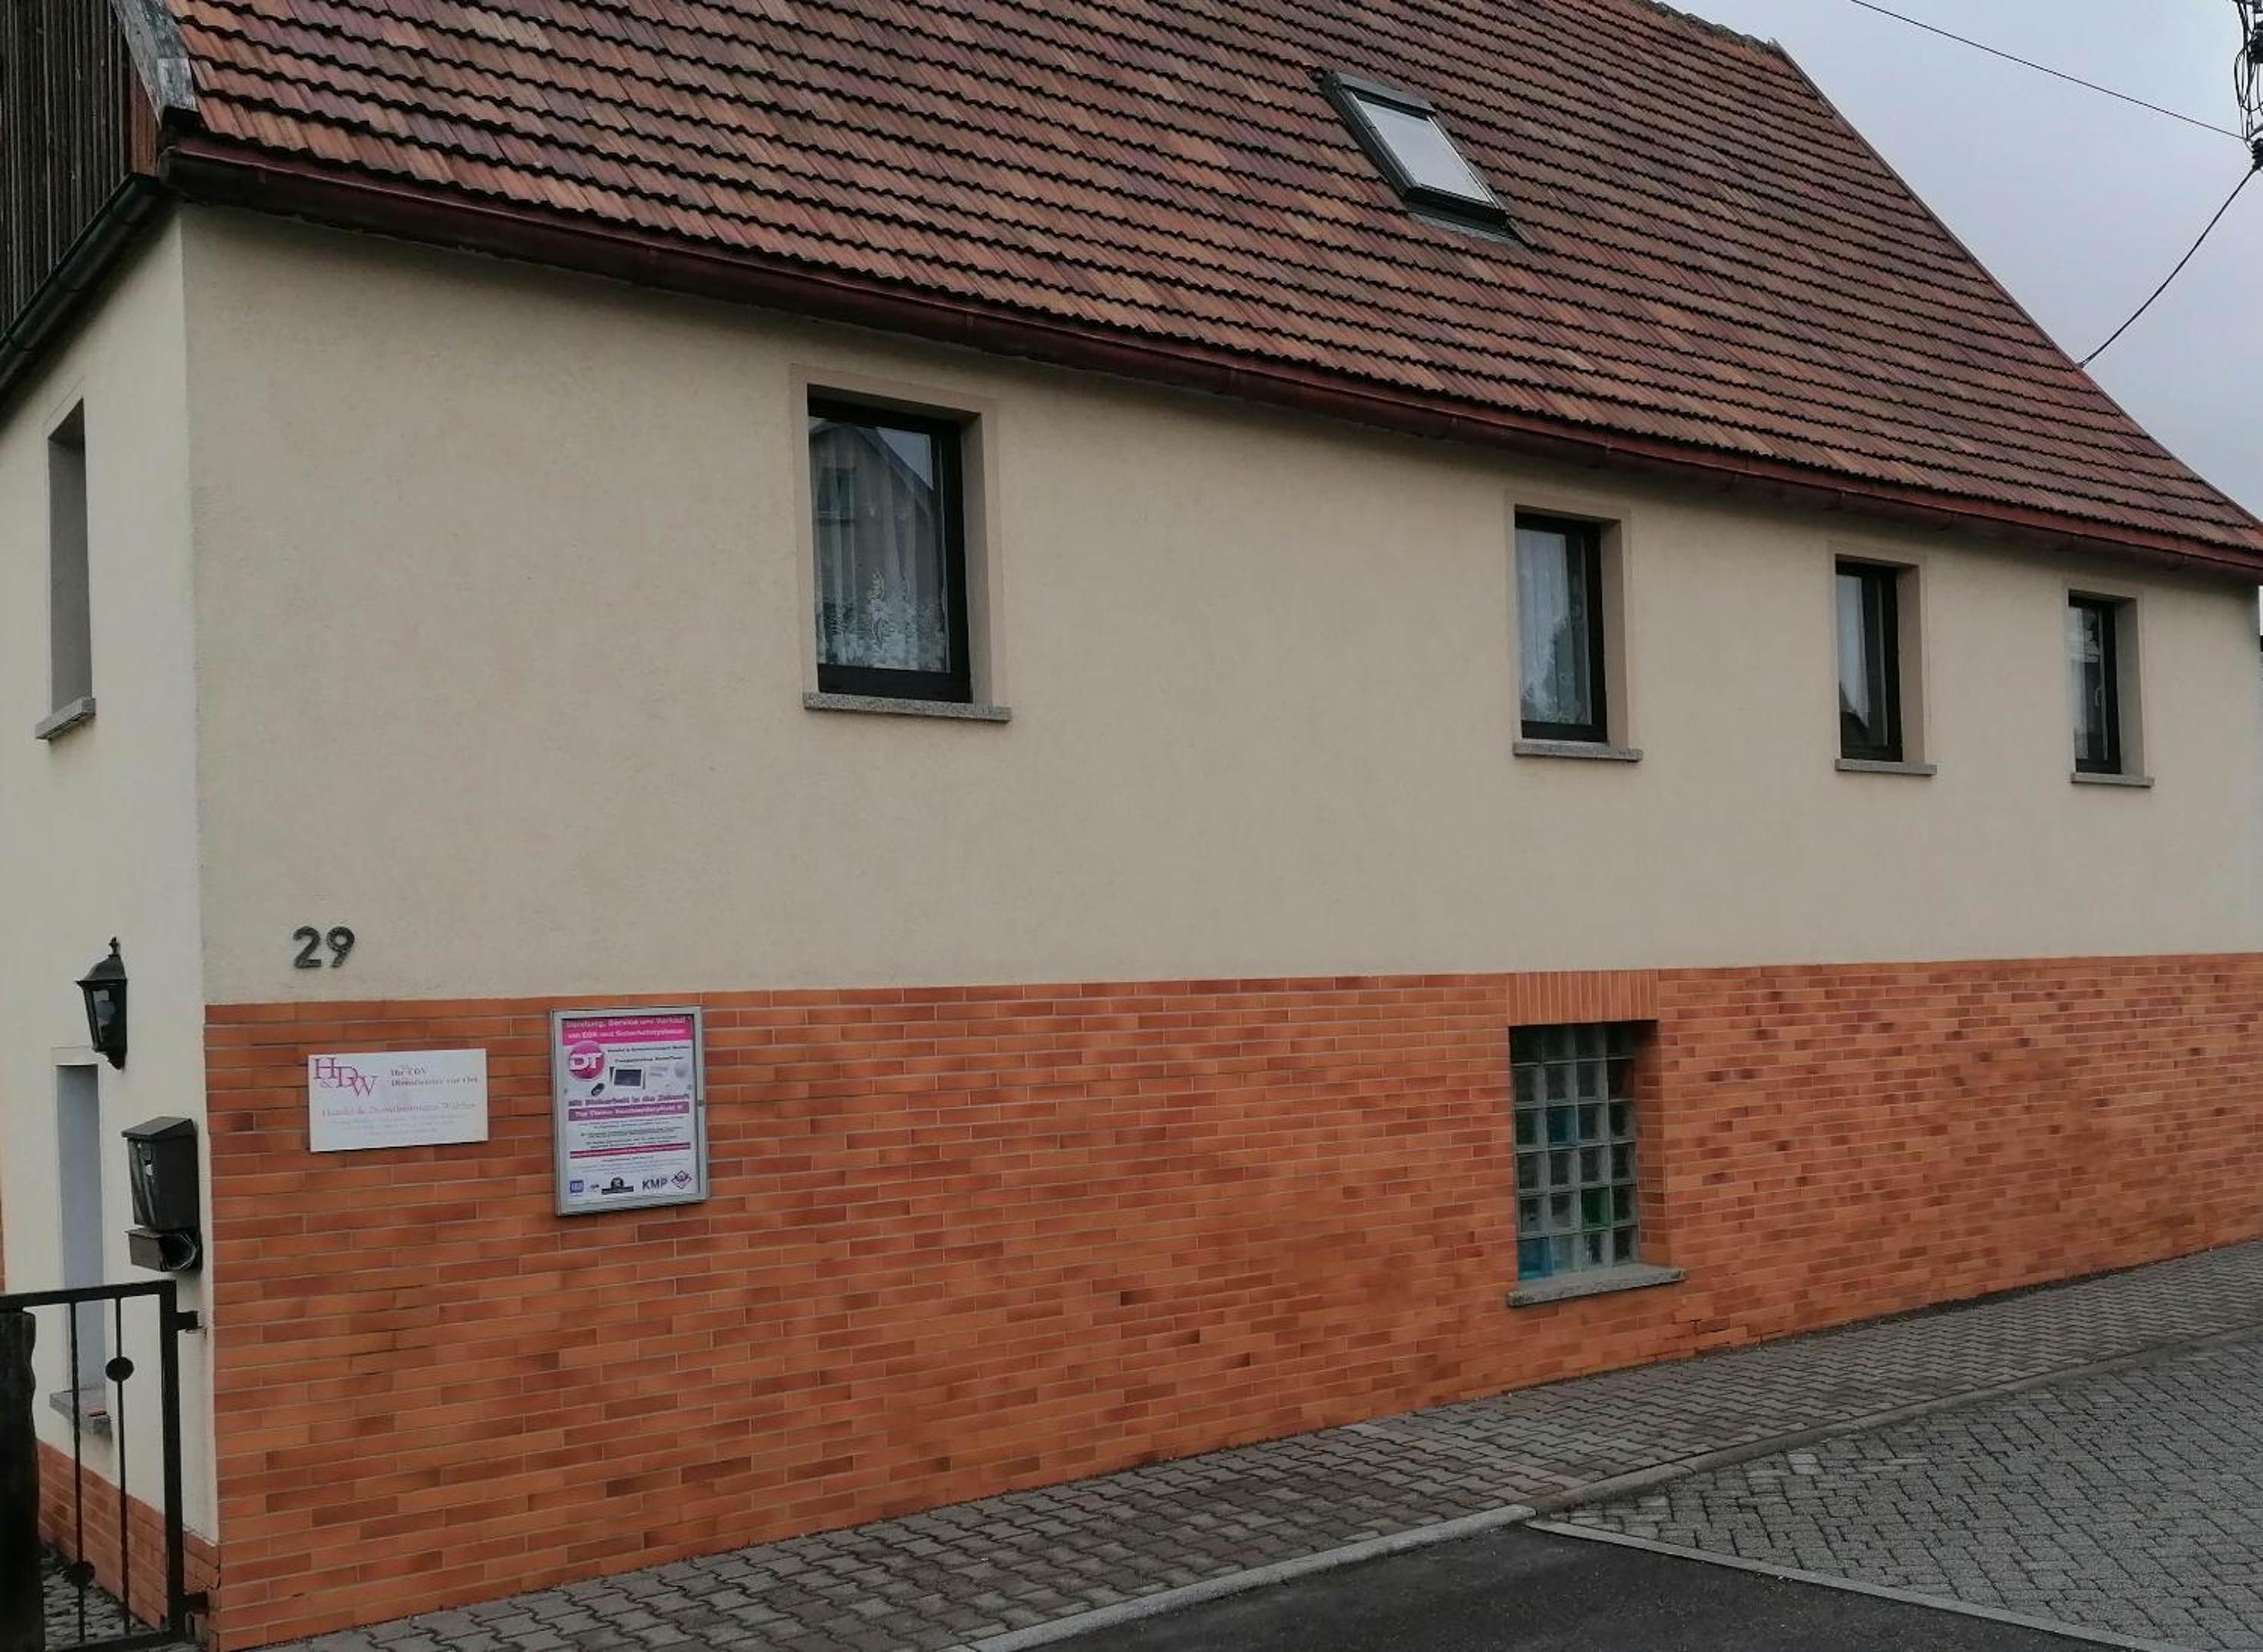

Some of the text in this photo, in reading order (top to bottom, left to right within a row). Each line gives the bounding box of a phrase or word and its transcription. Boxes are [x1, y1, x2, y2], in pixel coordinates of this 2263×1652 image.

[292, 926, 355, 969] 29
[607, 1018, 639, 1027] Service
[569, 1052, 603, 1070] DT
[643, 1178, 668, 1190] KMP
